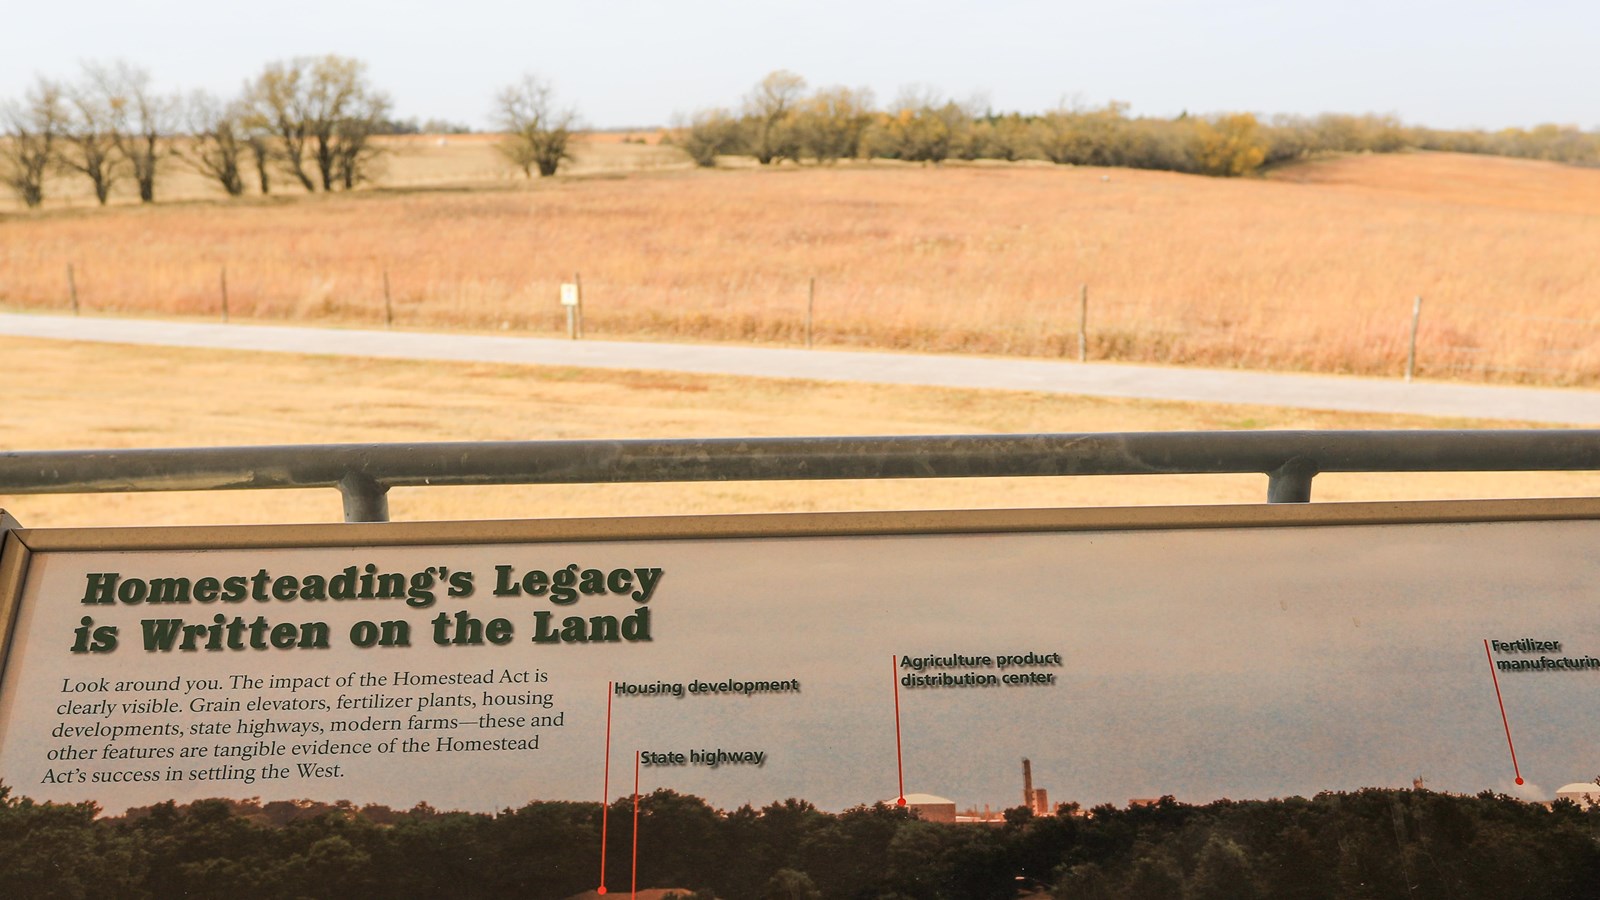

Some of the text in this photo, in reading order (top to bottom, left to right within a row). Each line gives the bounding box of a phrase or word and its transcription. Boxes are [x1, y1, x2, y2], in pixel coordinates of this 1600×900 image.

[81, 563, 663, 607] Homesteading’s Legacy
[70, 606, 652, 653] is Written on the Land
[1491, 638, 1560, 653] Fertilizer
[900, 651, 1061, 671] Agriculture product
[1496, 655, 1600, 671] manufacturin
[61, 668, 548, 695] Look around you. The impact of the Homestead Act is
[614, 678, 799, 696] Housing development
[901, 671, 1054, 688] distribution center
[56, 690, 554, 718] clearly visible. Grain elevators, fertilizer plants, housing
[51, 721, 184, 741] developments,
[189, 722, 232, 735] state
[236, 718, 324, 738] highways,
[330, 716, 401, 732] modern
[530, 711, 564, 727] and
[47, 734, 539, 761] other features are tangible evidence of the Homestead
[640, 748, 765, 767] State highway
[40, 762, 344, 785] Act’s success in settling the West.
